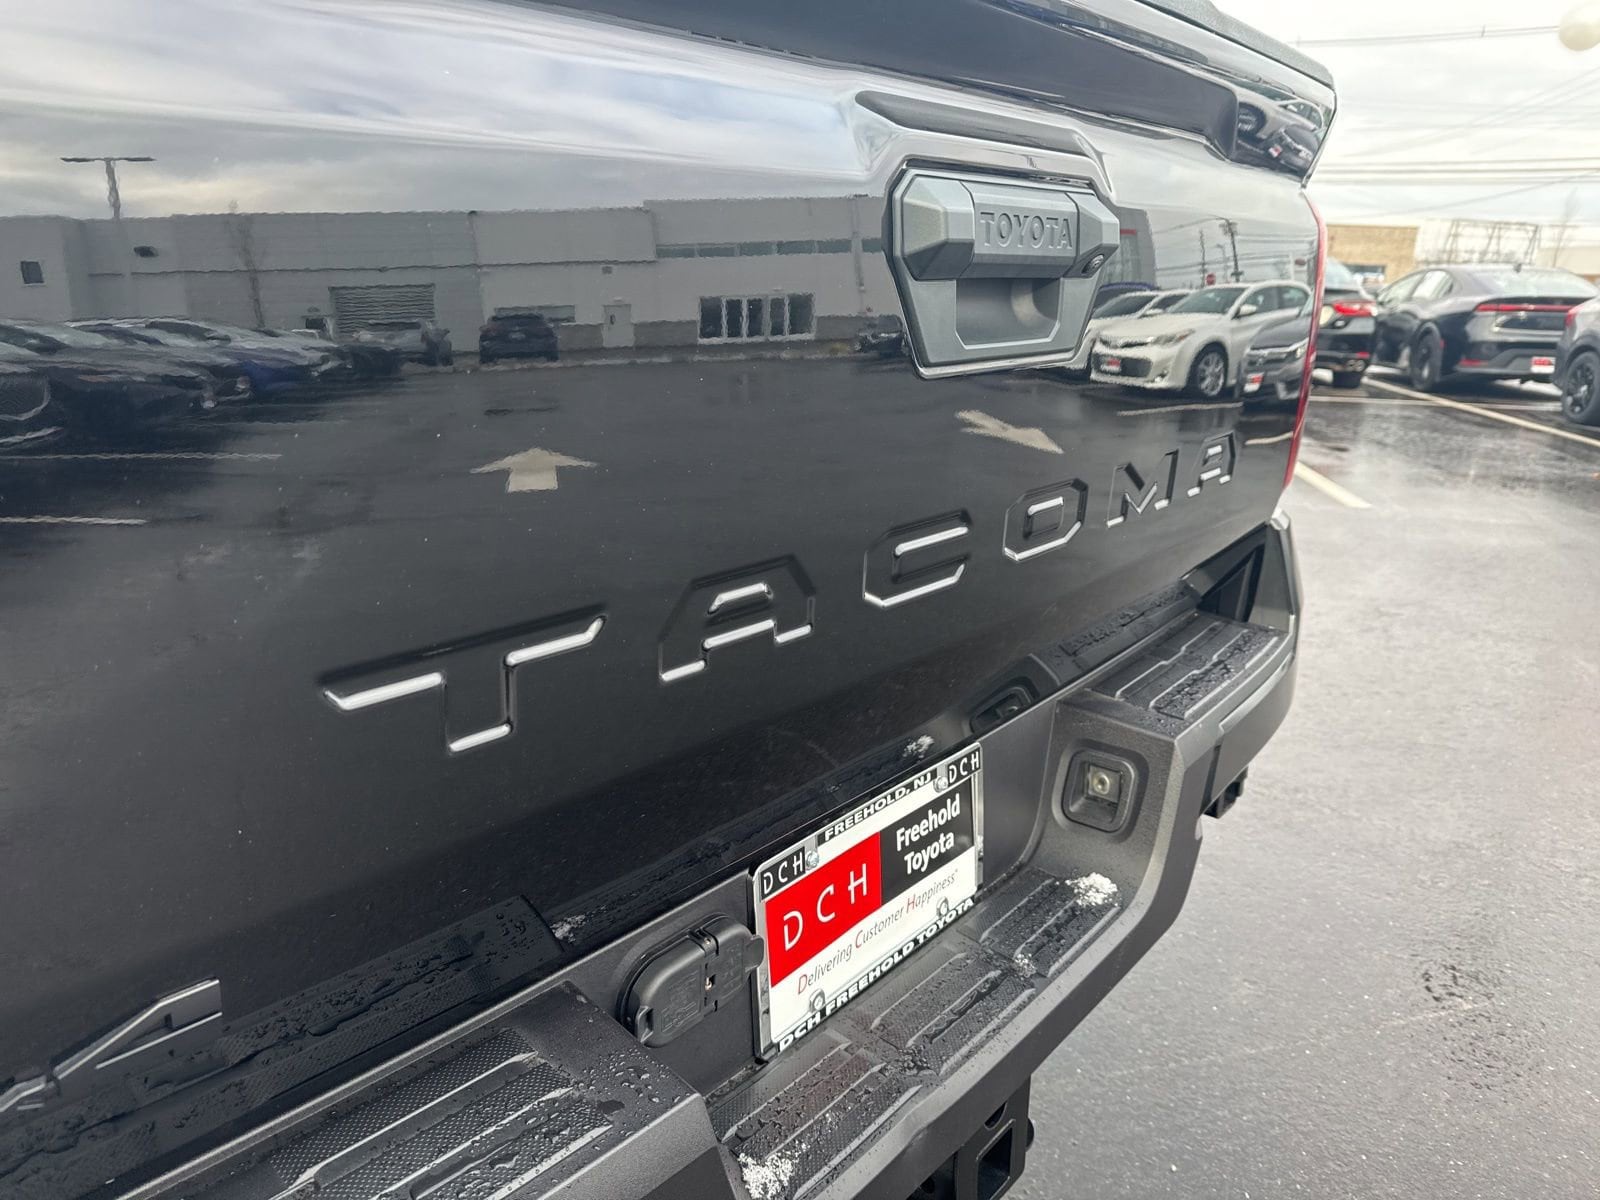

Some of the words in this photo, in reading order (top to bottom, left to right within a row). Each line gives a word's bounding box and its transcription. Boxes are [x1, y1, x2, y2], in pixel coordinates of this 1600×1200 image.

[980, 212, 1072, 249] TOYOTA
[314, 431, 1237, 756] TACOMA
[824, 788, 909, 841] FREEHOLD,
[913, 771, 932, 793] NJ
[896, 793, 961, 852] Freehold
[904, 831, 955, 876] Toyota
[778, 1012, 822, 1052] DCH
[825, 941, 916, 1015] FREEHOLD
[917, 897, 974, 944] TOYOTA
[797, 943, 853, 996] Delivering
[855, 906, 904, 949] Customer
